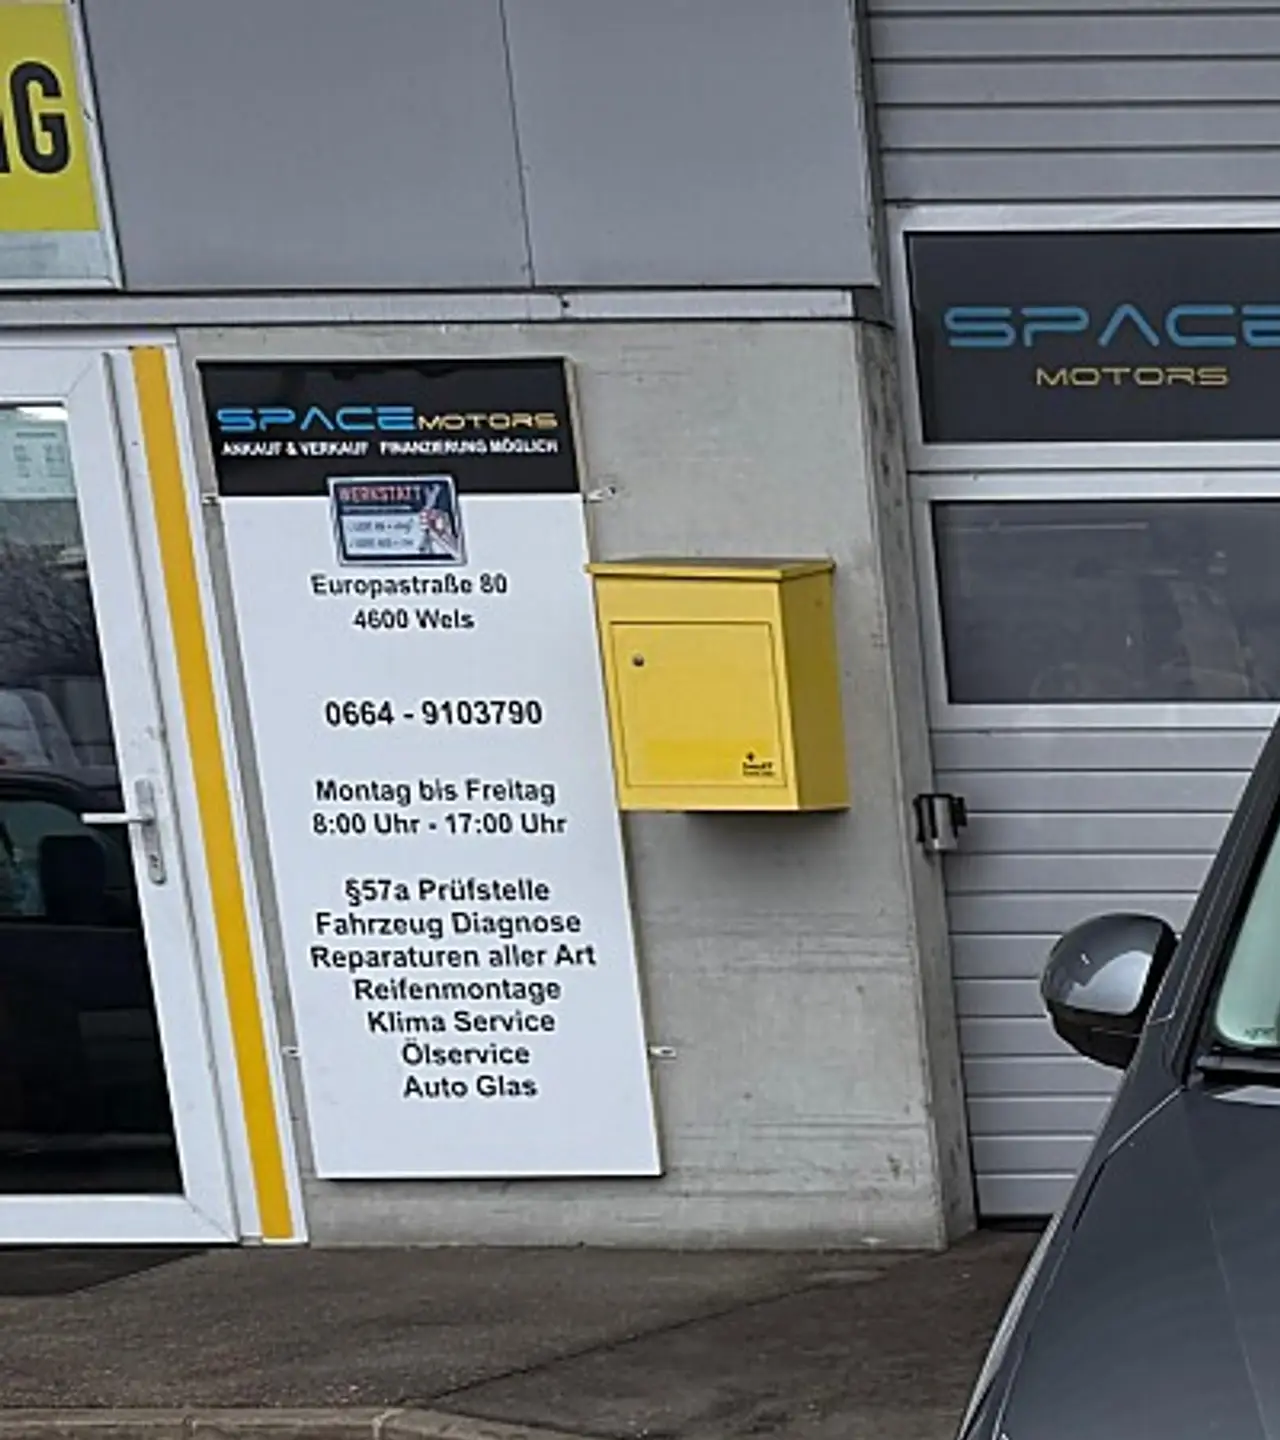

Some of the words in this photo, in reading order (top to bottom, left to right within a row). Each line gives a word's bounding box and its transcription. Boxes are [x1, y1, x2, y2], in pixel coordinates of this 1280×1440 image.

[0, 60, 70, 174] G
[1035, 367, 1230, 387] MOTORS
[216, 405, 416, 432] SPACE
[417, 412, 558, 431] MOTORS
[286, 441, 298, 456] &
[300, 440, 369, 456] VERKAUF
[311, 574, 472, 599] Europastraße
[480, 573, 507, 594] 80
[353, 609, 408, 630] 4600
[418, 609, 475, 630] Wels
[325, 700, 394, 726] 0664
[422, 700, 543, 726] 9103790
[316, 779, 411, 807] Montag
[419, 779, 458, 801] bis
[464, 779, 556, 806] Freitag
[313, 812, 366, 834] 8:00
[374, 812, 421, 834] Uhr
[446, 812, 513, 834] 17:00
[521, 812, 567, 834] Uhr
[345, 879, 411, 907] §57a
[419, 877, 550, 901] Prüfstelle
[316, 911, 444, 939] Fahrzeug
[452, 912, 581, 938] Diagnose
[310, 946, 479, 973] Reparaturen
[489, 945, 547, 967] aller
[555, 944, 596, 966] Art
[353, 978, 561, 1006] Reifenmontage
[368, 1010, 447, 1033] Klima
[454, 1010, 556, 1033] Service
[402, 1038, 530, 1065] Ölservice
[403, 1075, 469, 1098] Auto
[477, 1075, 537, 1097] Glas
